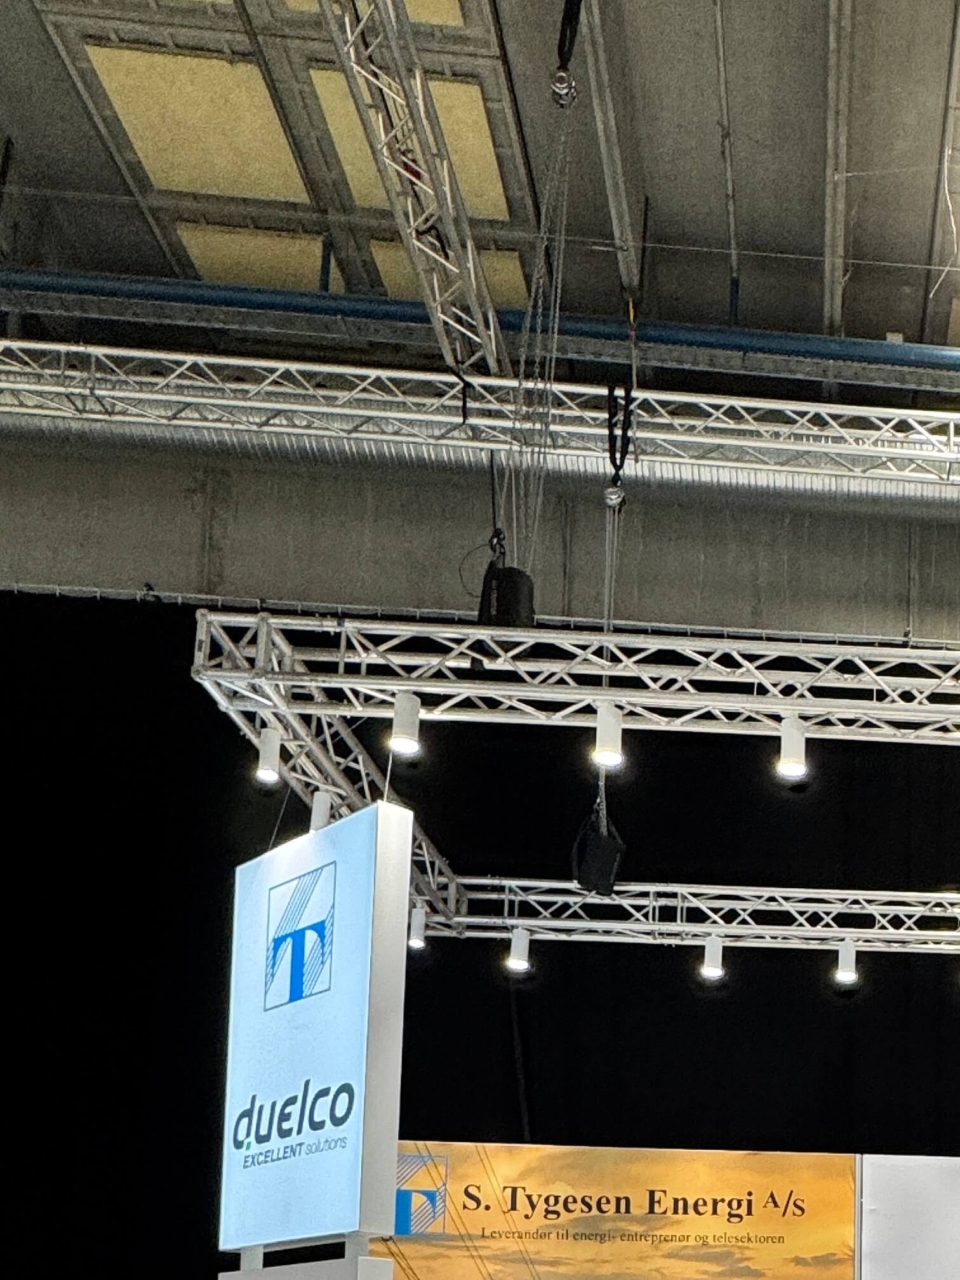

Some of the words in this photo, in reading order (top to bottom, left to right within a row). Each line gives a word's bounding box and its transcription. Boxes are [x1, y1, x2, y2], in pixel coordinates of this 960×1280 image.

[232, 1078, 355, 1151] duelco
[242, 1141, 305, 1169] EXCELLENT
[304, 1136, 348, 1156] solutions
[462, 1183, 491, 1212] S.
[502, 1186, 631, 1223] Tygesen
[645, 1188, 754, 1224] Energi
[481, 1227, 552, 1240] Leverandør
[556, 1228, 569, 1241] til
[572, 1228, 616, 1244] energi-
[619, 1231, 691, 1246] entreprenør
[694, 1234, 709, 1246] og
[712, 1231, 785, 1245] telesektoren
